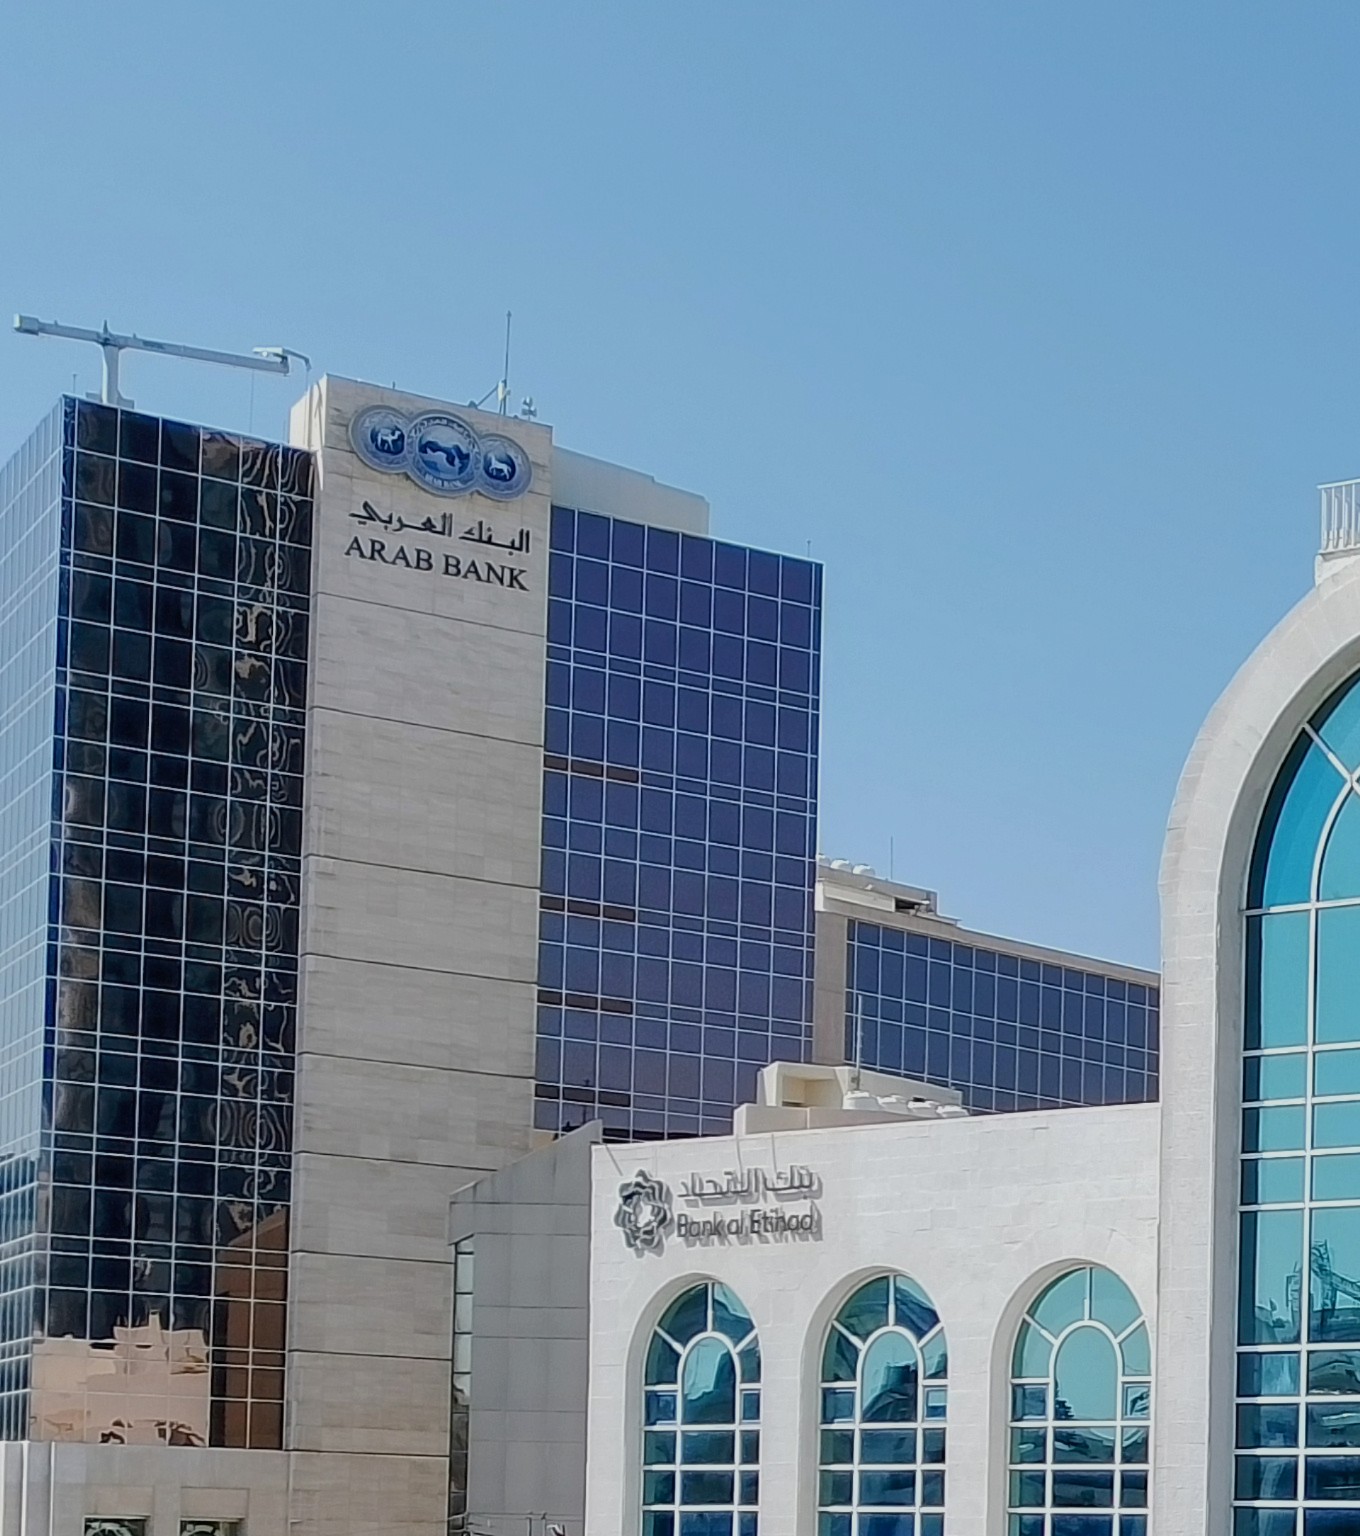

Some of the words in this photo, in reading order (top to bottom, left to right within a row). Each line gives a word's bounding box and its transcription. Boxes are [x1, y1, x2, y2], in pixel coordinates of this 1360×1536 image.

[348, 500, 454, 538] العربي
[458, 519, 531, 556] البنك
[344, 535, 434, 572] ARAB
[442, 553, 529, 592] BANK
[676, 1211, 722, 1238] Bank
[726, 1209, 744, 1235] al
[750, 1200, 814, 1234] Etihad
